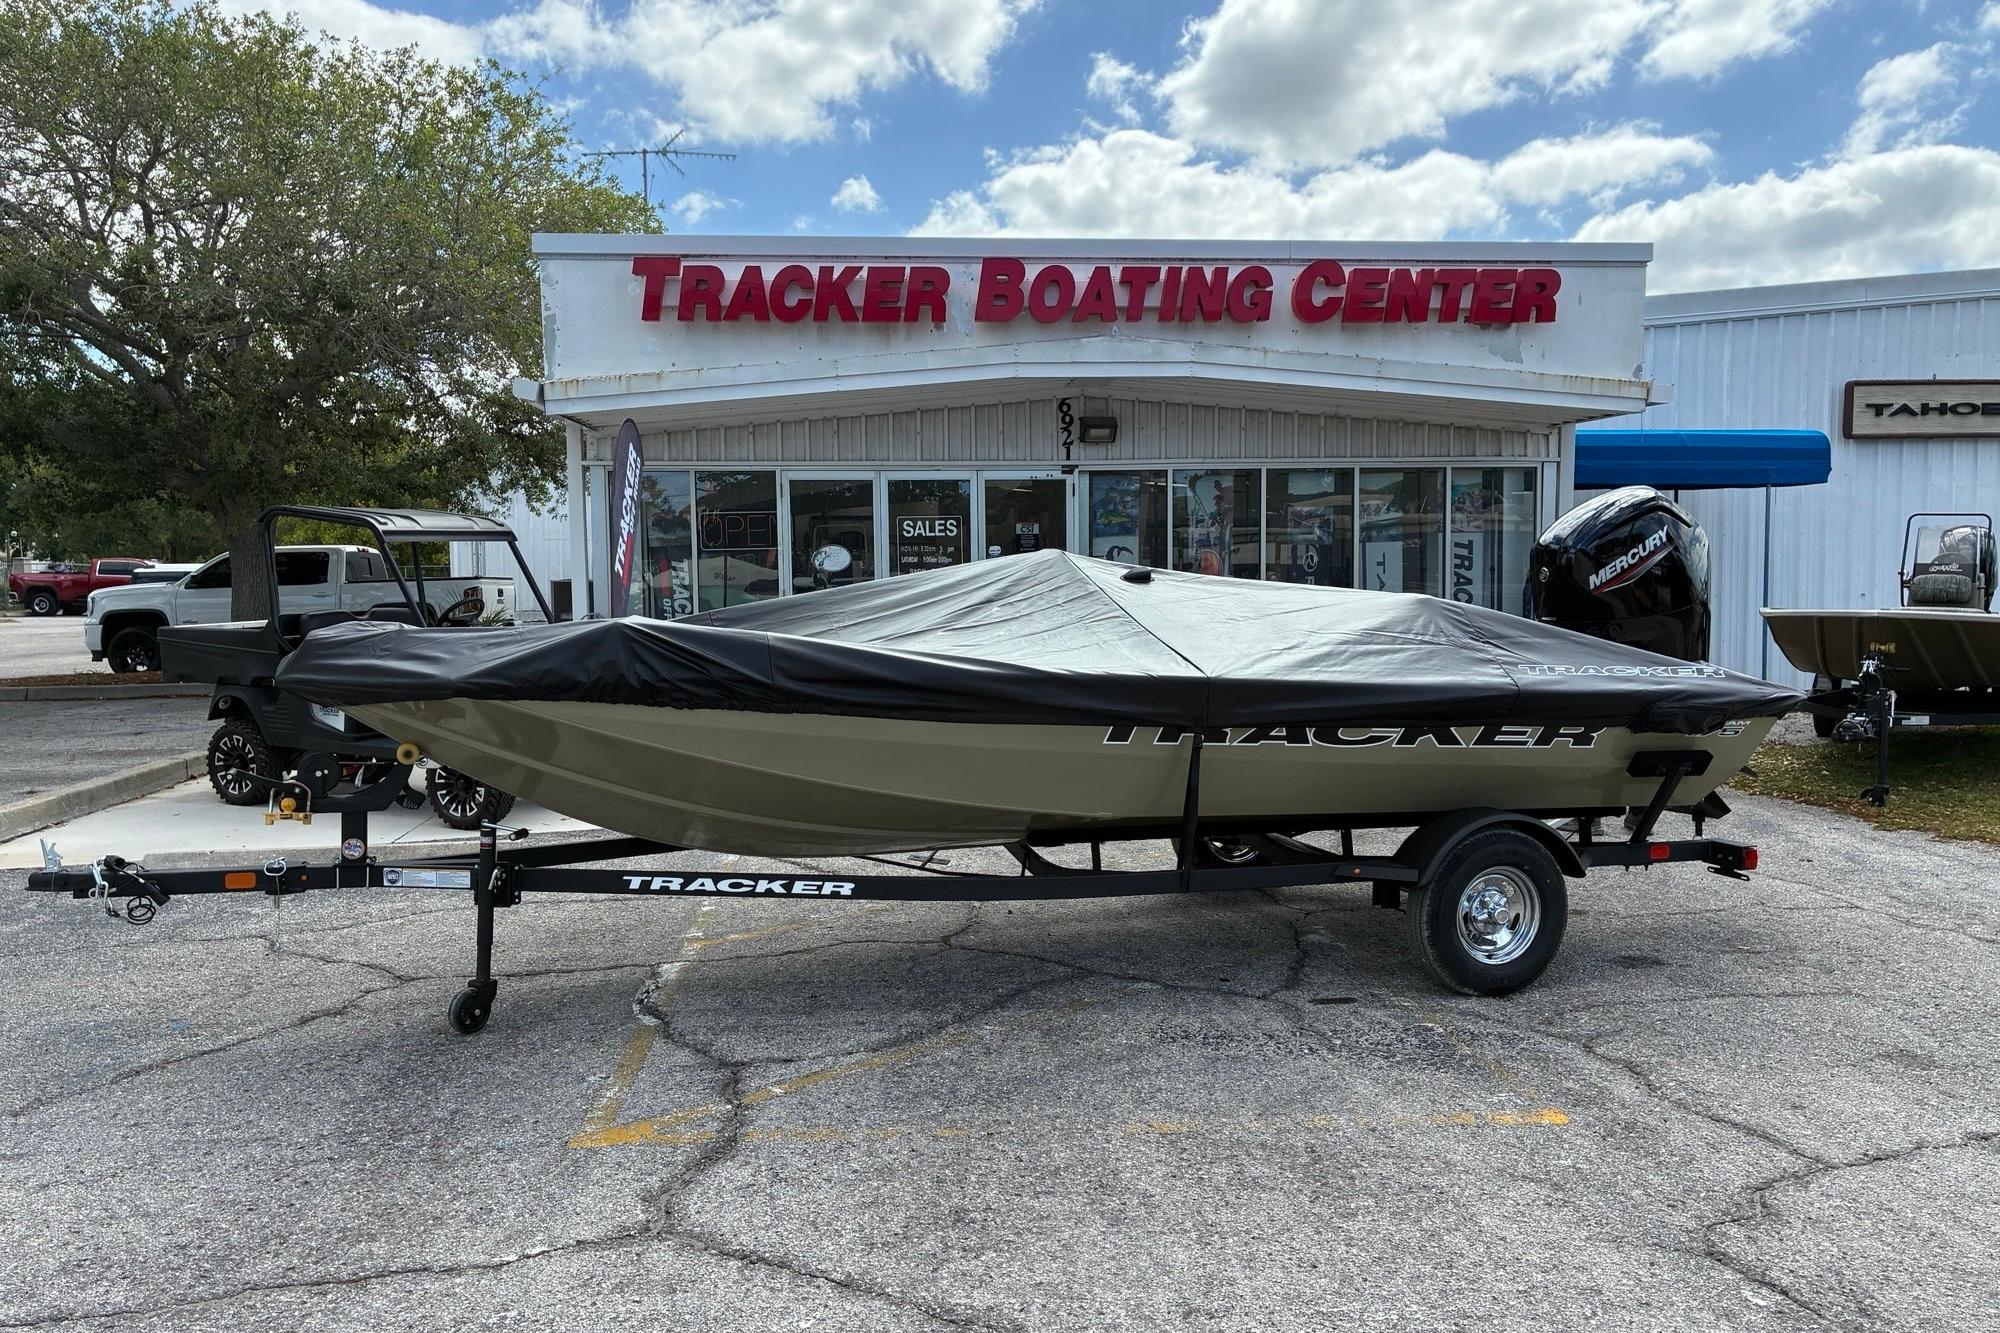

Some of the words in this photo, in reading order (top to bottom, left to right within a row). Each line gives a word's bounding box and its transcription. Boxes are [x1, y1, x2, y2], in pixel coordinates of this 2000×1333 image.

[632, 257, 950, 322] TRACKER
[974, 257, 1273, 323] BOATING
[1291, 259, 1561, 324] CENTER
[1058, 399, 1075, 461] 6921
[614, 441, 637, 578] TRACKER
[902, 520, 958, 537] SALES
[1588, 525, 1668, 590] MERCURY
[1518, 664, 1726, 678] TRACKER
[622, 875, 856, 896] TRACKER
